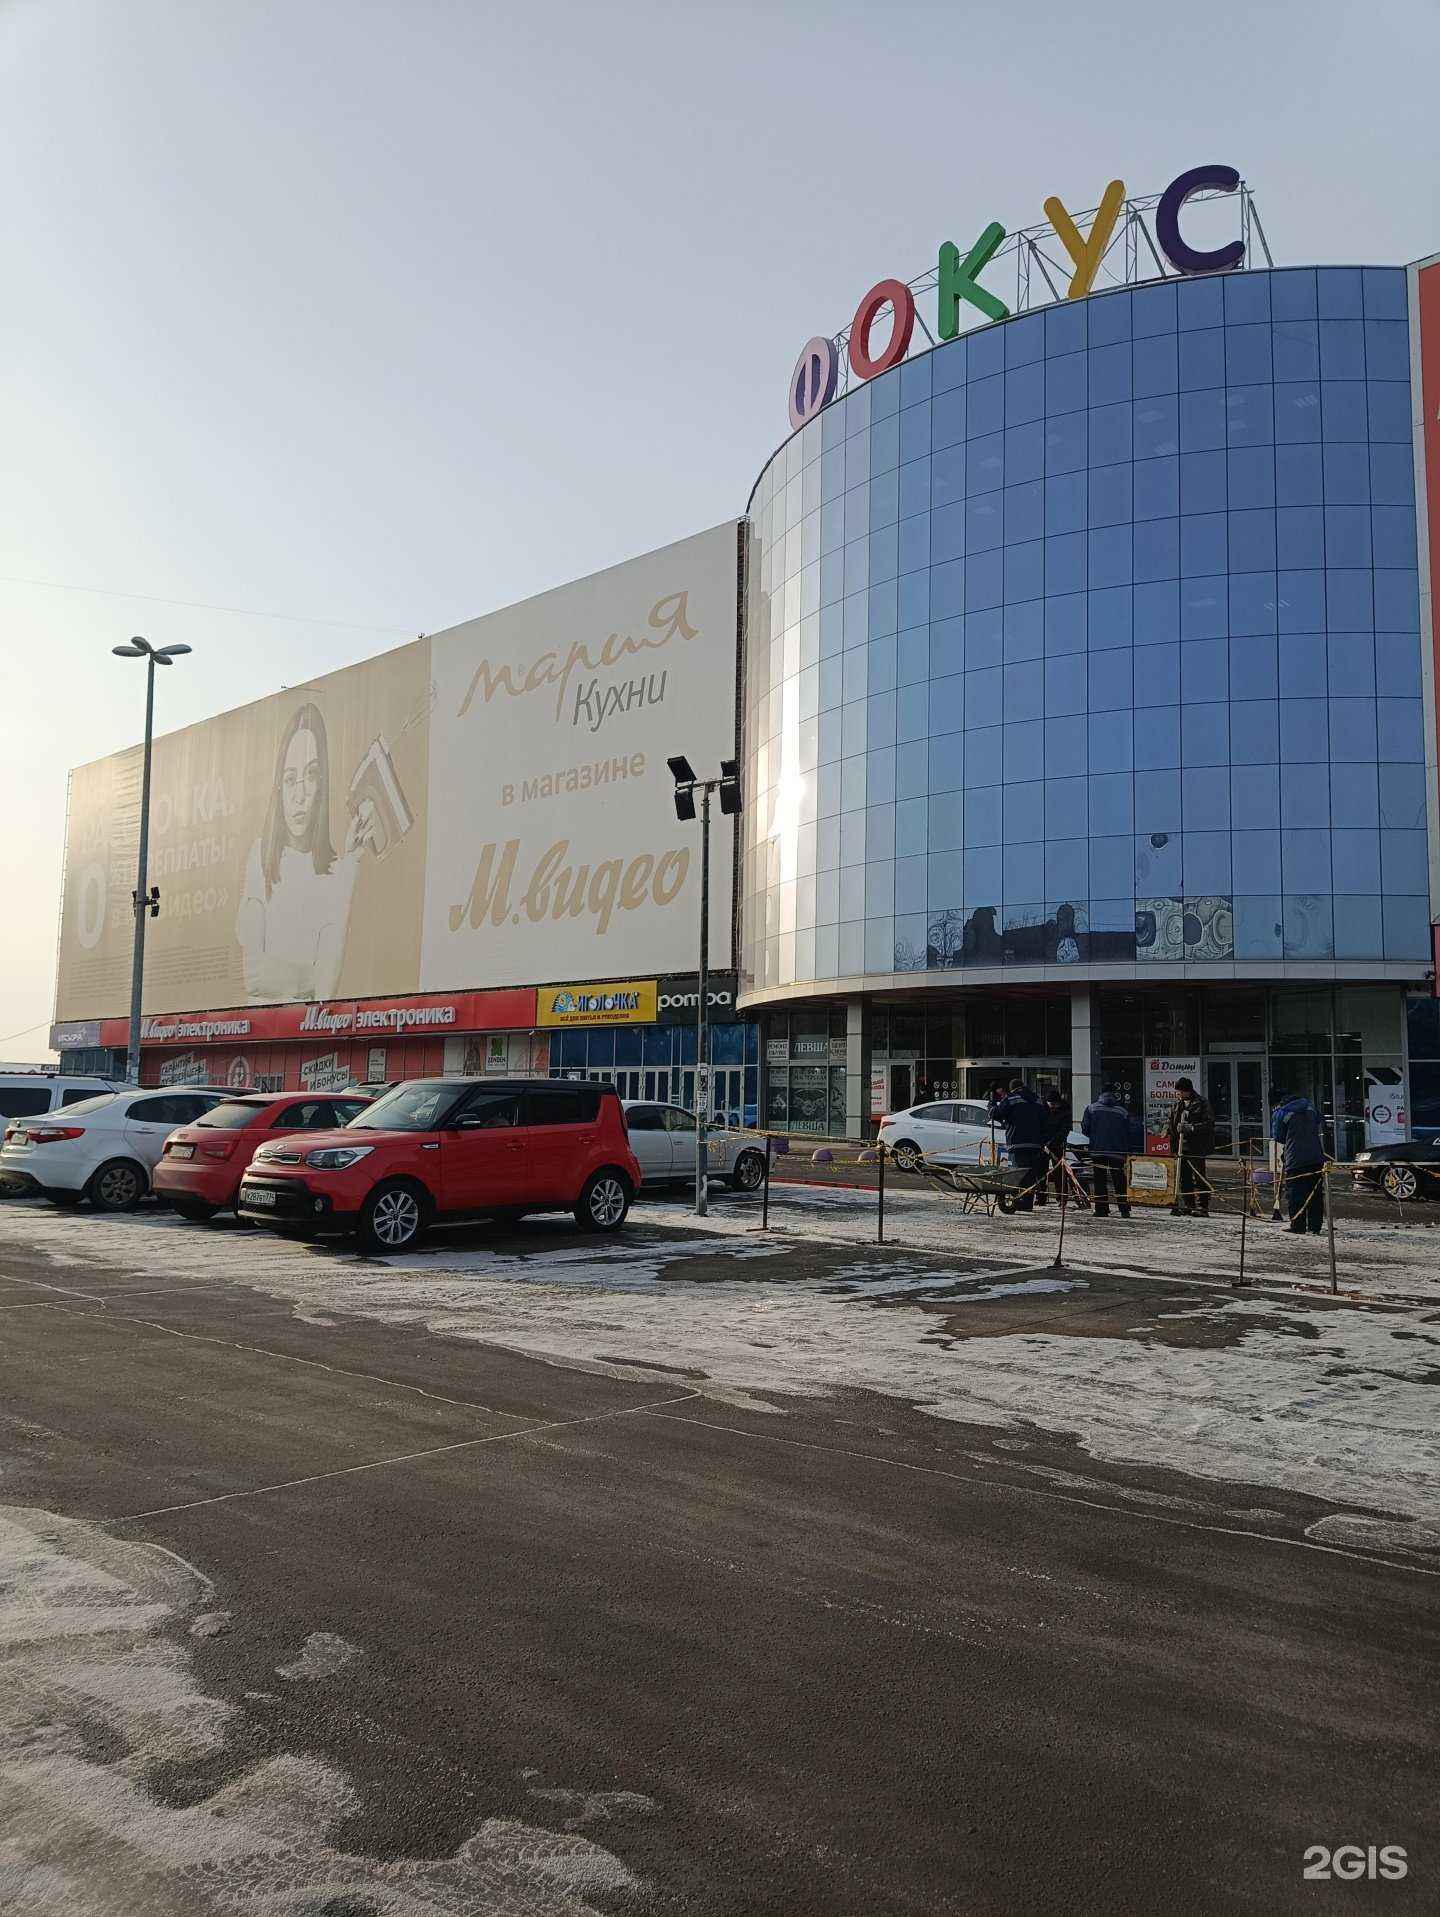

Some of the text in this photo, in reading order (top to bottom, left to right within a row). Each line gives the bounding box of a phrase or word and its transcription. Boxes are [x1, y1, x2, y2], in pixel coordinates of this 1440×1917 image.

[789, 164, 1246, 430] ФОКУС
[572, 670, 667, 732] Кухни
[501, 751, 648, 807] в магазине
[448, 838, 691, 935] М.видео
[177, 1019, 251, 1041] электроника
[299, 1005, 456, 1034] М.видео электроника
[303, 1059, 333, 1076] СКИДКИ
[316, 1069, 348, 1089] БОНУСЫ
[1155, 1080, 1175, 1089] САМ
